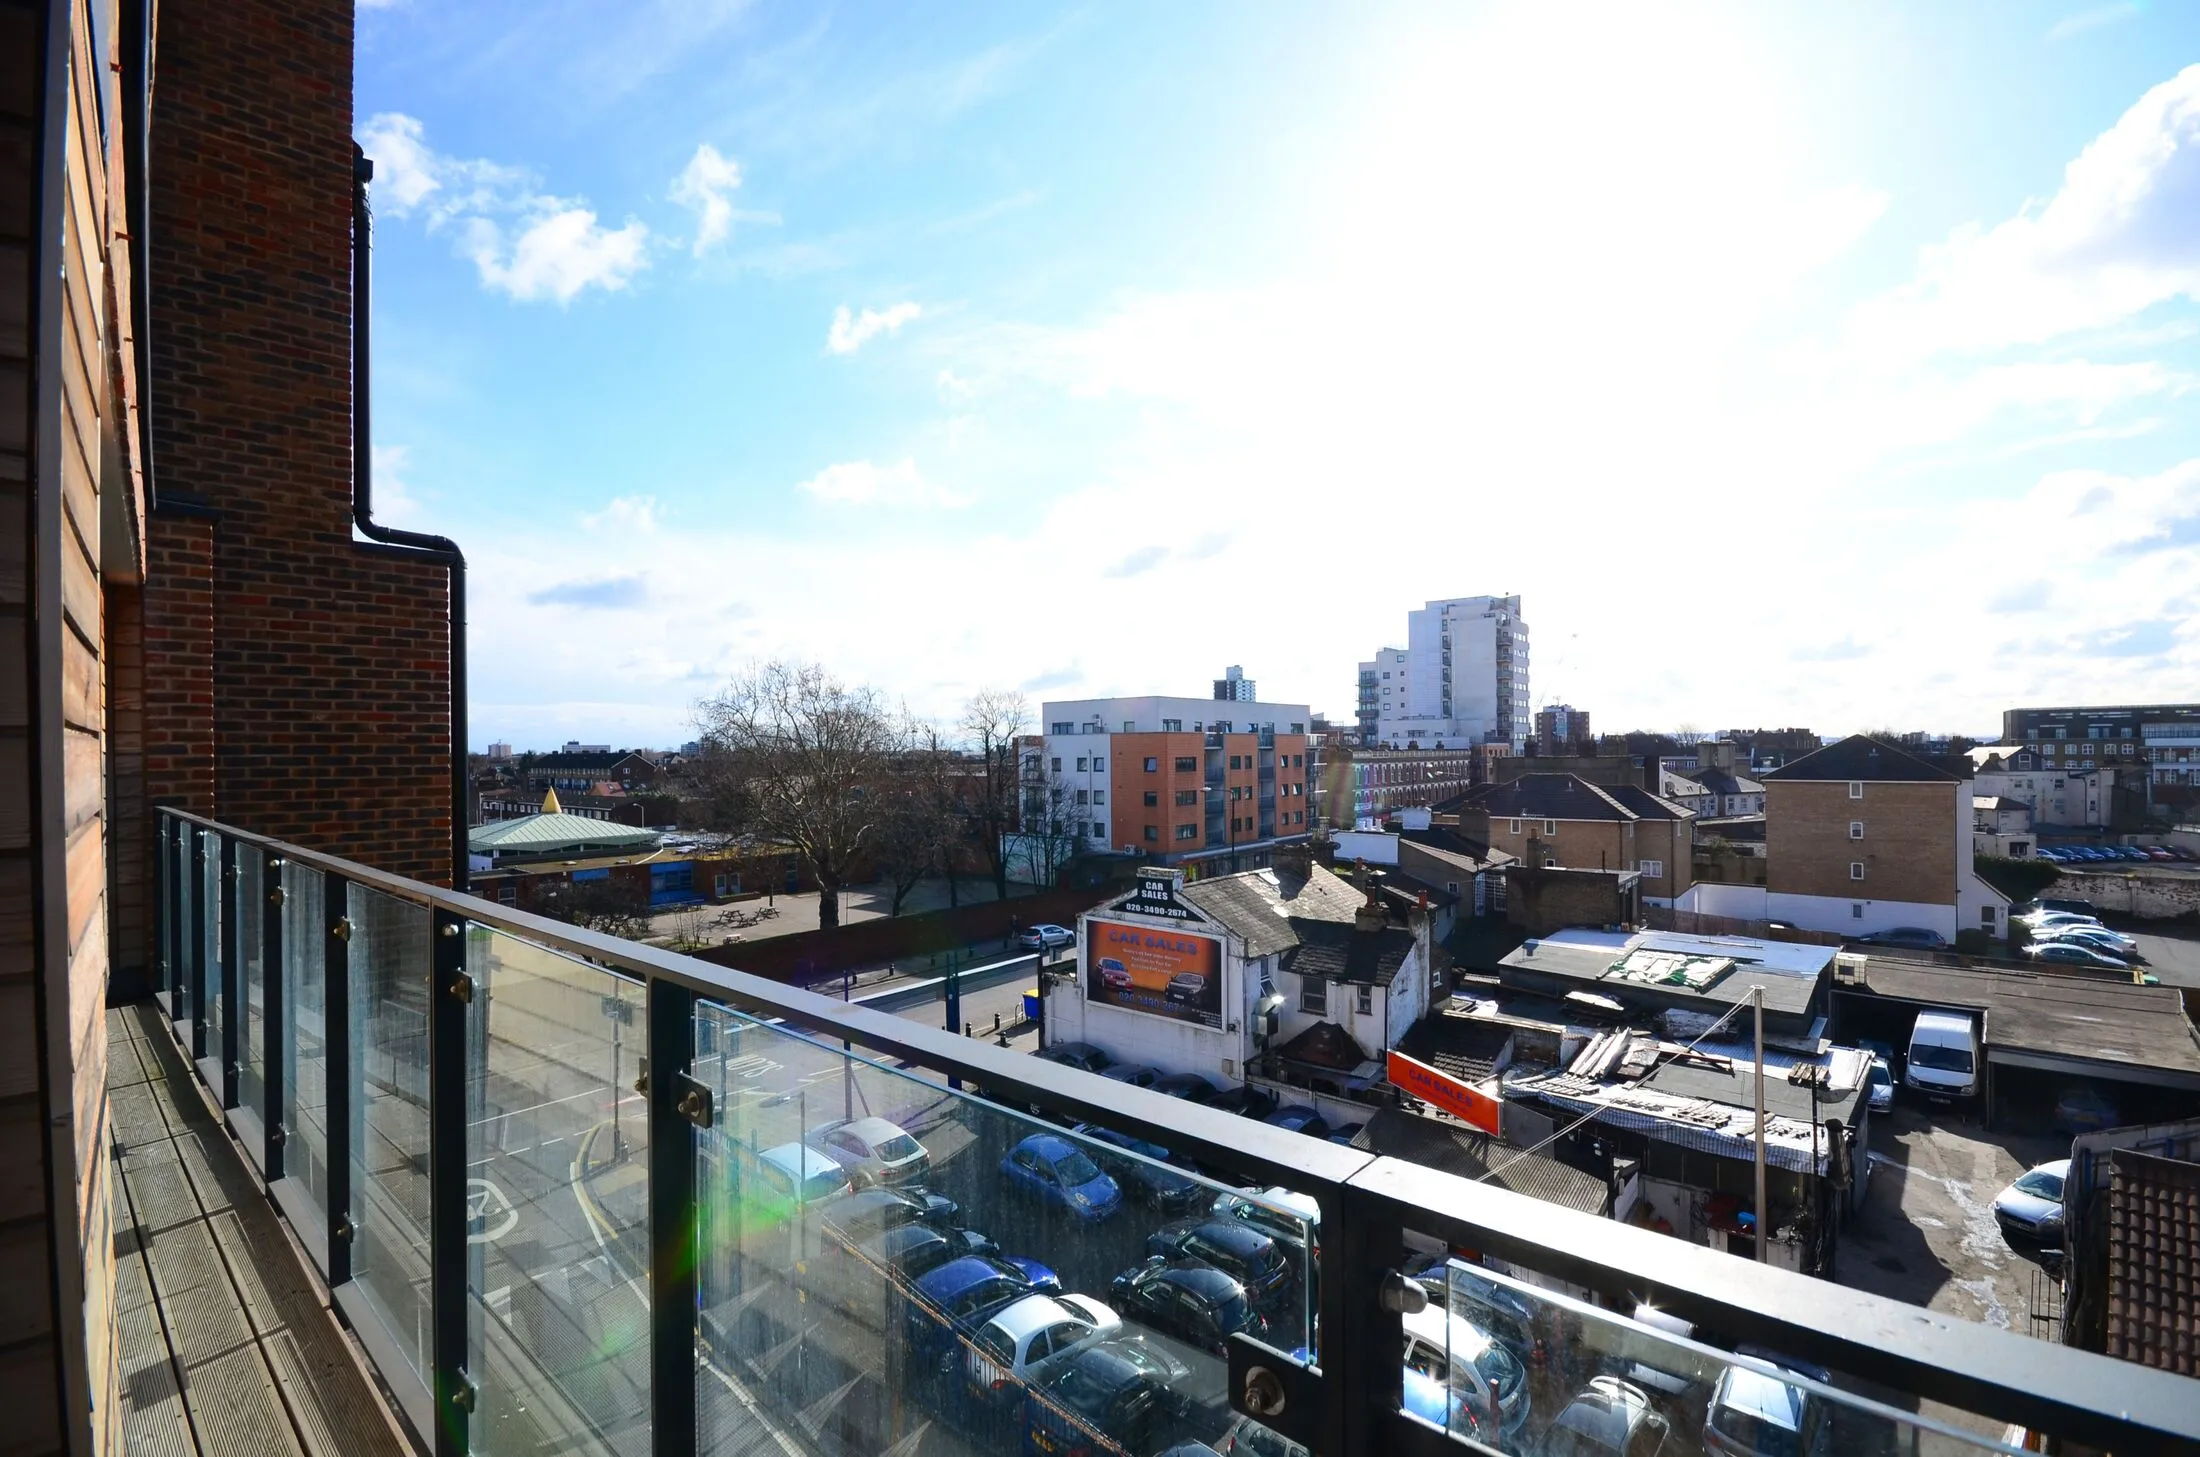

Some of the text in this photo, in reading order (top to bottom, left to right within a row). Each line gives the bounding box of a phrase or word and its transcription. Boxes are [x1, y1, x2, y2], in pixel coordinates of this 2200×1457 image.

[1145, 881, 1164, 891] CAR
[1141, 889, 1169, 901] SALES
[1126, 903, 1187, 918] 020-3490-2674
[1108, 929, 1140, 946] CAR
[1145, 935, 1198, 956] SALES
[1408, 1068, 1432, 1087] CAR
[1433, 1080, 1474, 1108] SALES
